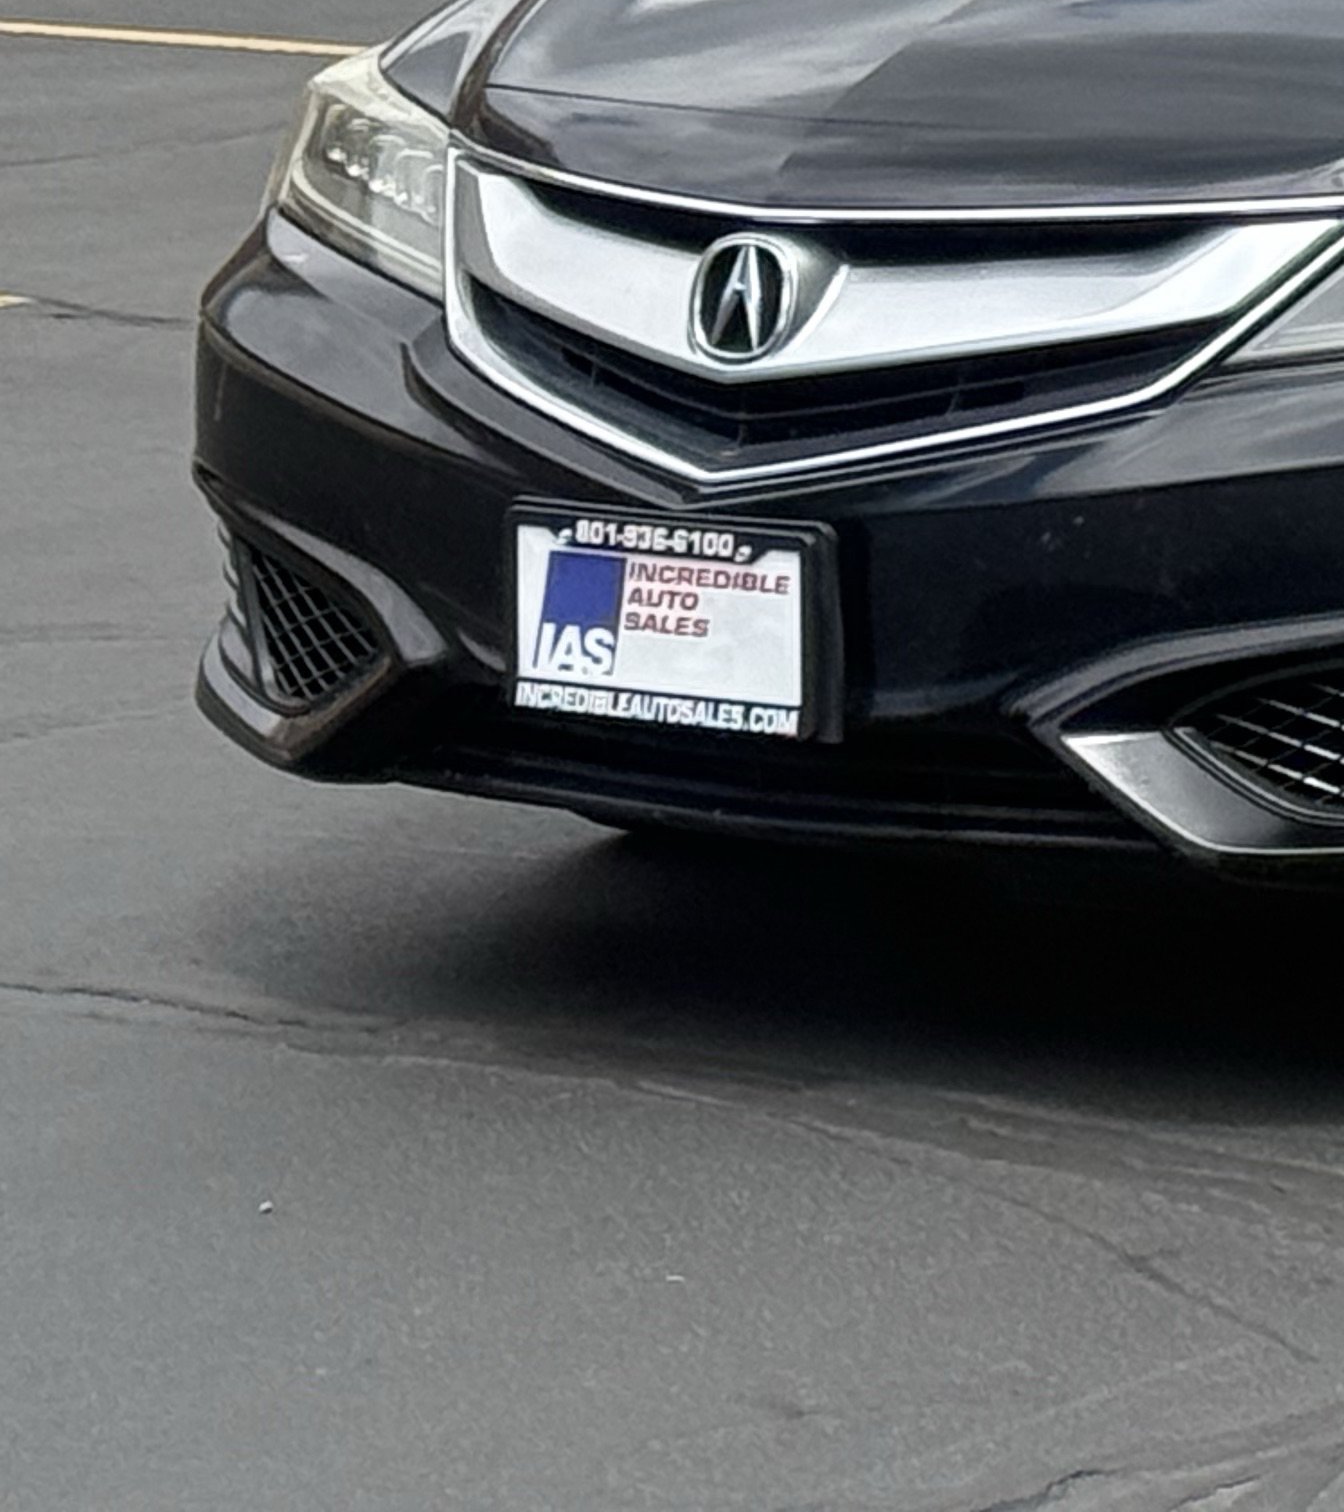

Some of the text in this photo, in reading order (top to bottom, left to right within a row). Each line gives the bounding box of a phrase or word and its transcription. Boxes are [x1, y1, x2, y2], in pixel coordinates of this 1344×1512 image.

[628, 562, 791, 596] INCREDIBLE
[626, 587, 700, 612] AUTO
[623, 611, 711, 638] SALES
[536, 621, 616, 676] IAS
[514, 680, 800, 737] INCREDIBLEAUTOSALES.COM
